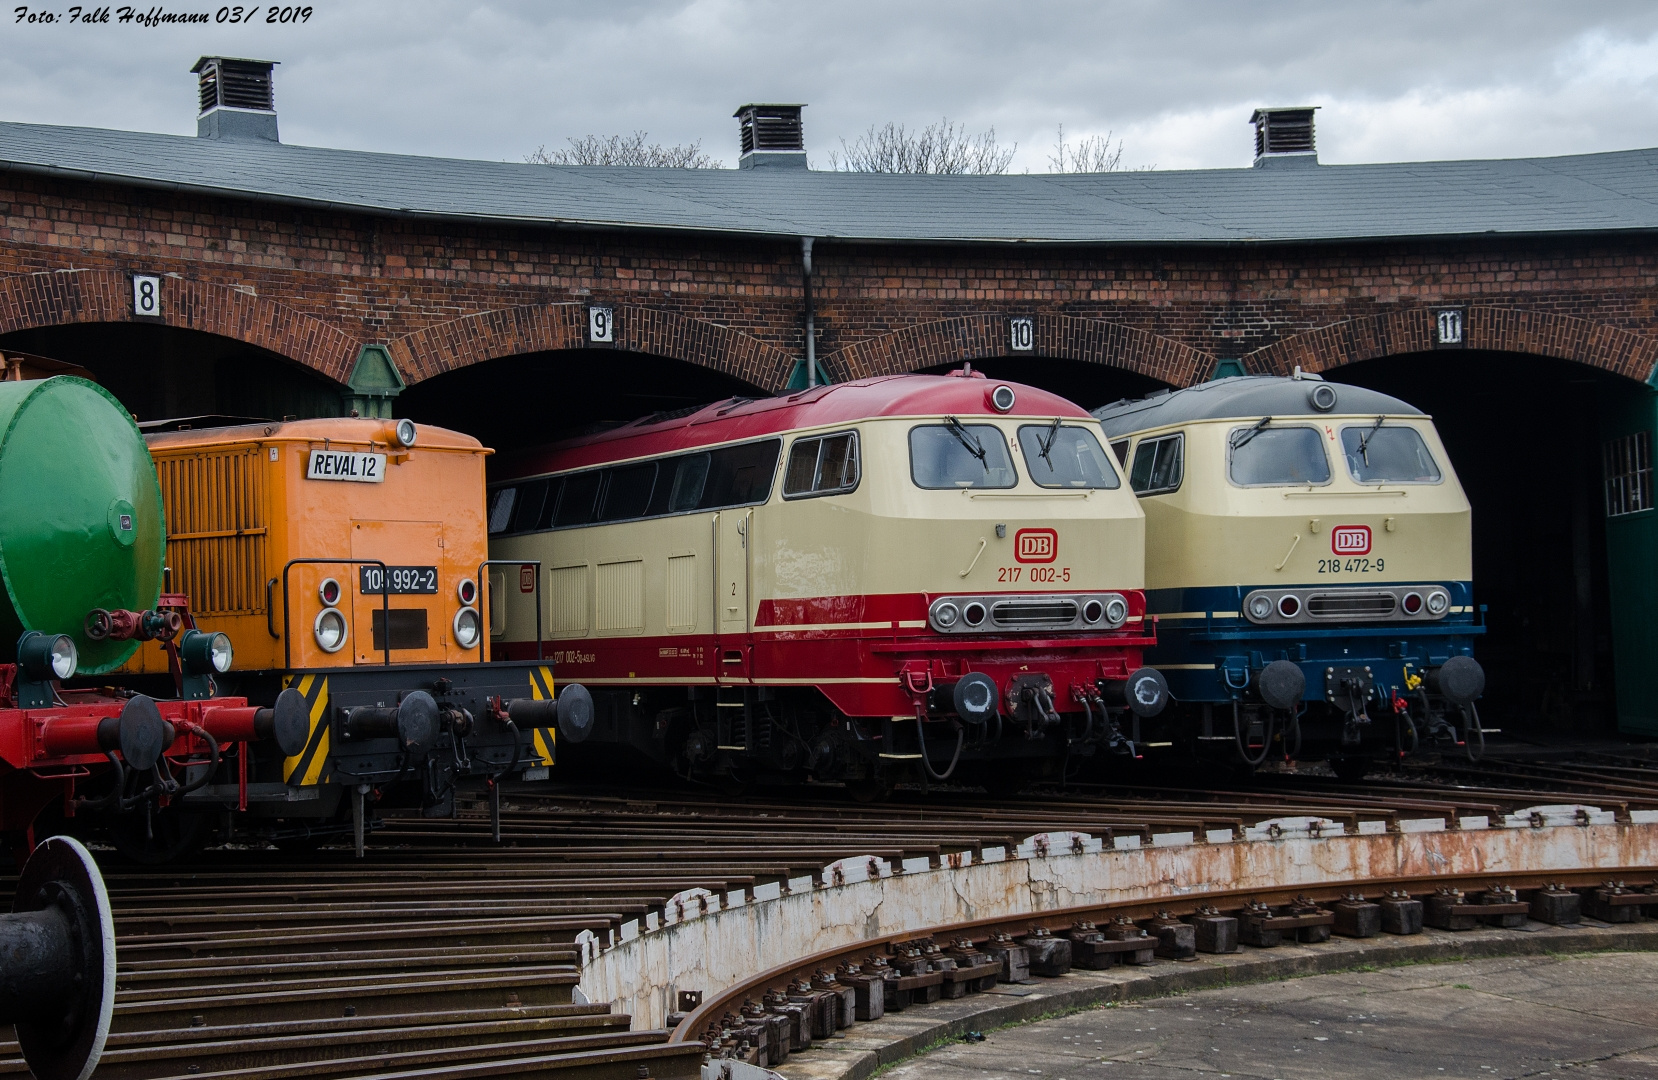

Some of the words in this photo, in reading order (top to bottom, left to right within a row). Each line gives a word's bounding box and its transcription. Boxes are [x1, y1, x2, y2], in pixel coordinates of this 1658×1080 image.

[140, 281, 154, 311] 8
[595, 312, 606, 338] 9
[1013, 322, 1030, 347] 10
[1441, 315, 1456, 340] 11
[314, 454, 358, 476] REVAL
[362, 456, 377, 477] 12
[1022, 537, 1050, 555] DB
[1338, 533, 1365, 549] DB
[997, 567, 1022, 582] 217
[1030, 567, 1070, 582] 002-5
[1318, 559, 1341, 573] 218
[1345, 558, 1385, 573] 472-9
[393, 569, 435, 590] 992-2
[731, 582, 736, 596] 2
